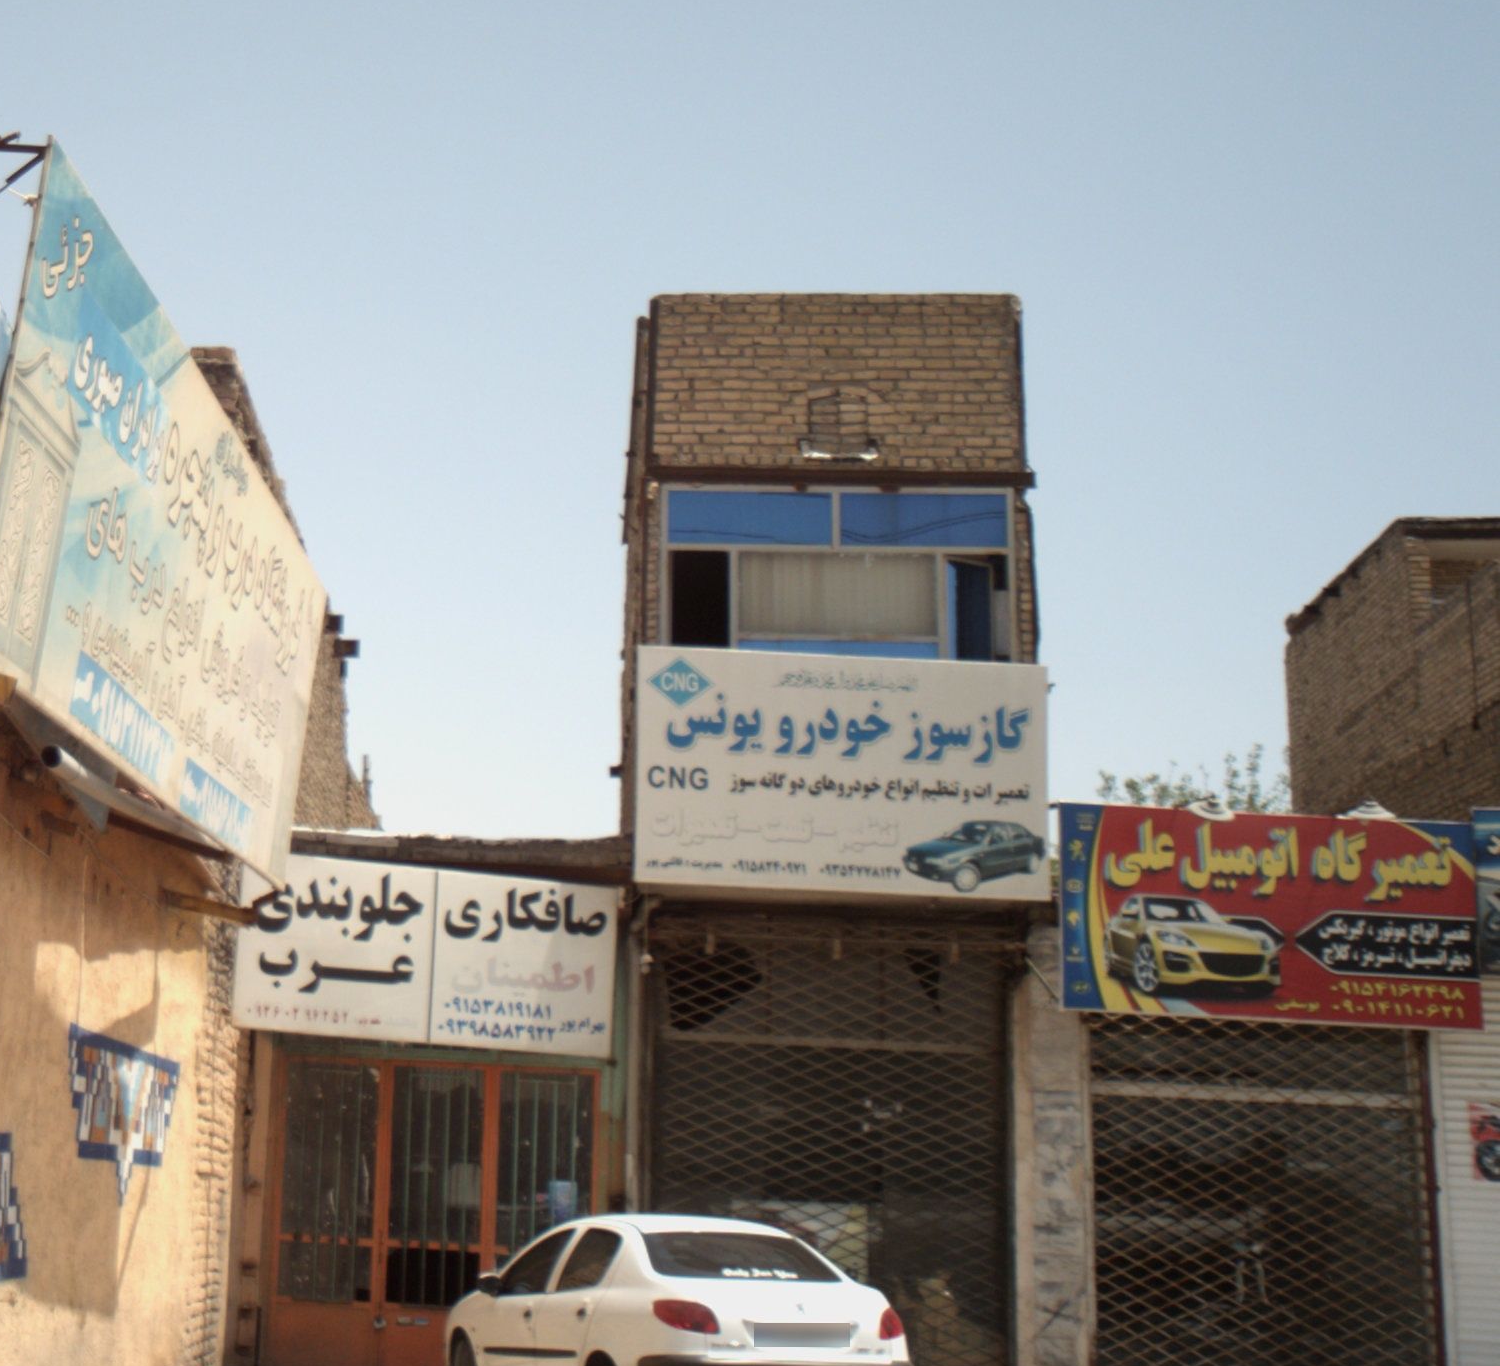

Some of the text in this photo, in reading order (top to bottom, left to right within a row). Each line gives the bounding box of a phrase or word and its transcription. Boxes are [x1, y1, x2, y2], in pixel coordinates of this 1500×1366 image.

[73, 333, 123, 413] صبوری
[164, 420, 215, 567] پنجره
[86, 486, 127, 565] های
[129, 540, 165, 616] درب
[223, 518, 259, 612] درب
[660, 673, 700, 693] CNG
[666, 692, 762, 752] یونس
[774, 698, 891, 758] خودرو
[648, 766, 709, 790] CNG
[884, 780, 920, 801] انواع
[921, 780, 960, 801] تنظیم
[1104, 818, 1177, 889] علی
[1181, 821, 1299, 897] اتومبیل
[257, 873, 607, 943] صافکاری جلوبندی
[1408, 922, 1439, 945] انواع
[258, 946, 415, 993] عرب
[451, 955, 596, 997] اطمینان
